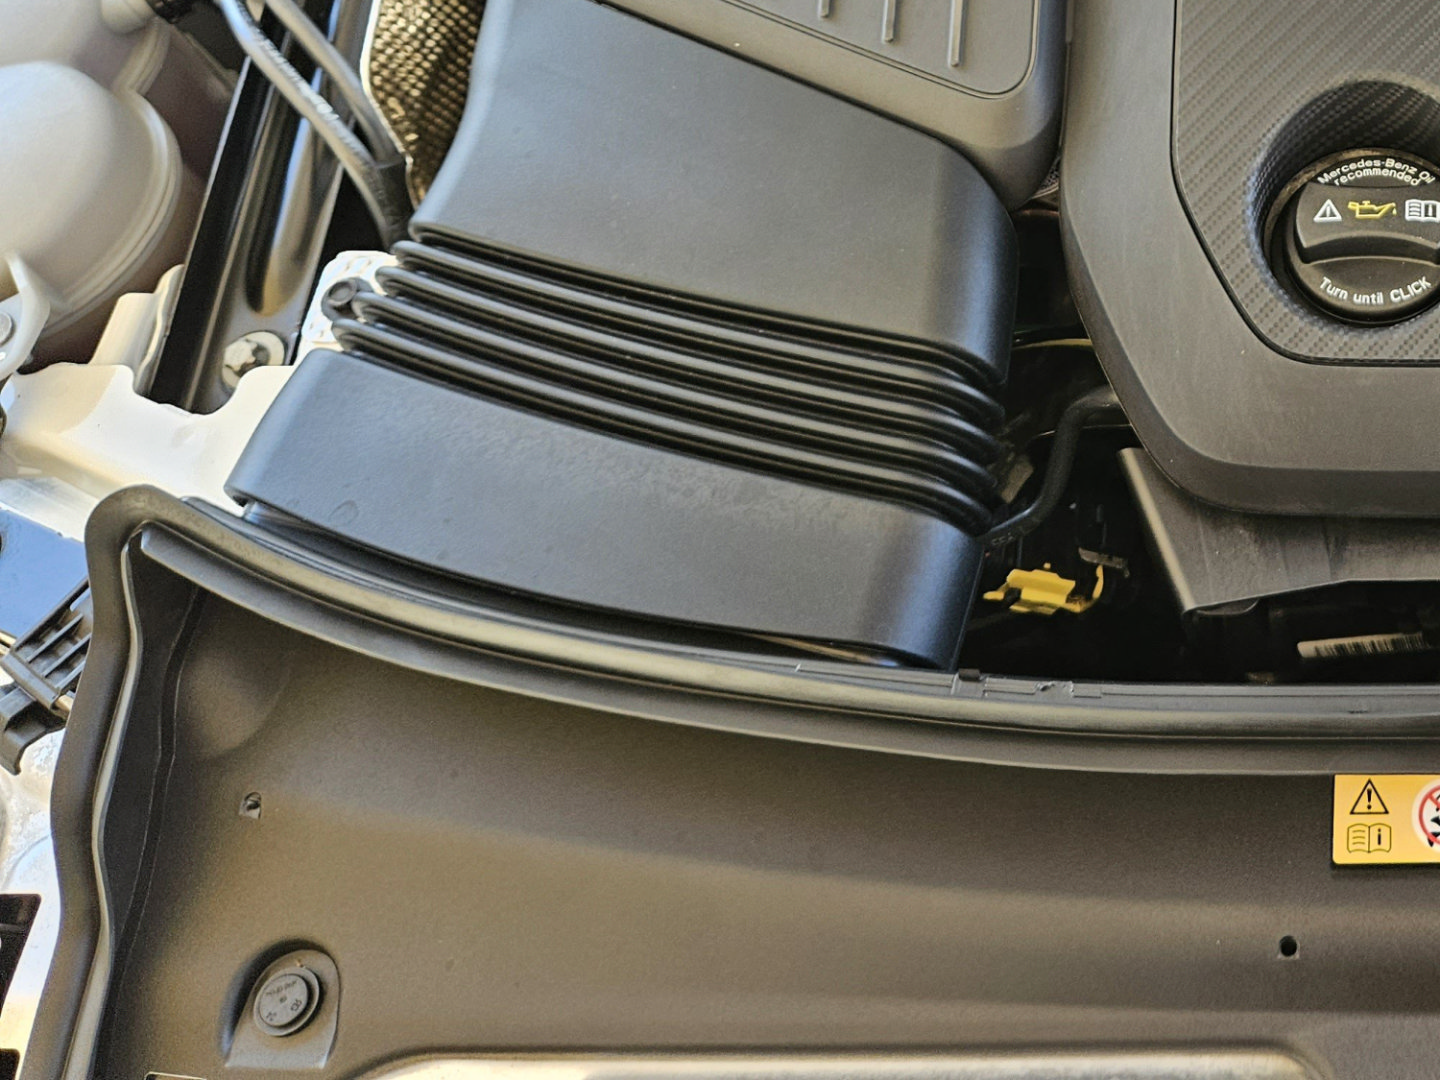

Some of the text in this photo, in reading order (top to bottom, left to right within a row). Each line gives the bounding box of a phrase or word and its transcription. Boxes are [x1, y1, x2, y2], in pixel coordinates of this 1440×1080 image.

[1317, 157, 1436, 184] Mercedes-Benz Oil
[1333, 167, 1421, 186] recommended
[1319, 276, 1432, 304] Turn until CLICK
